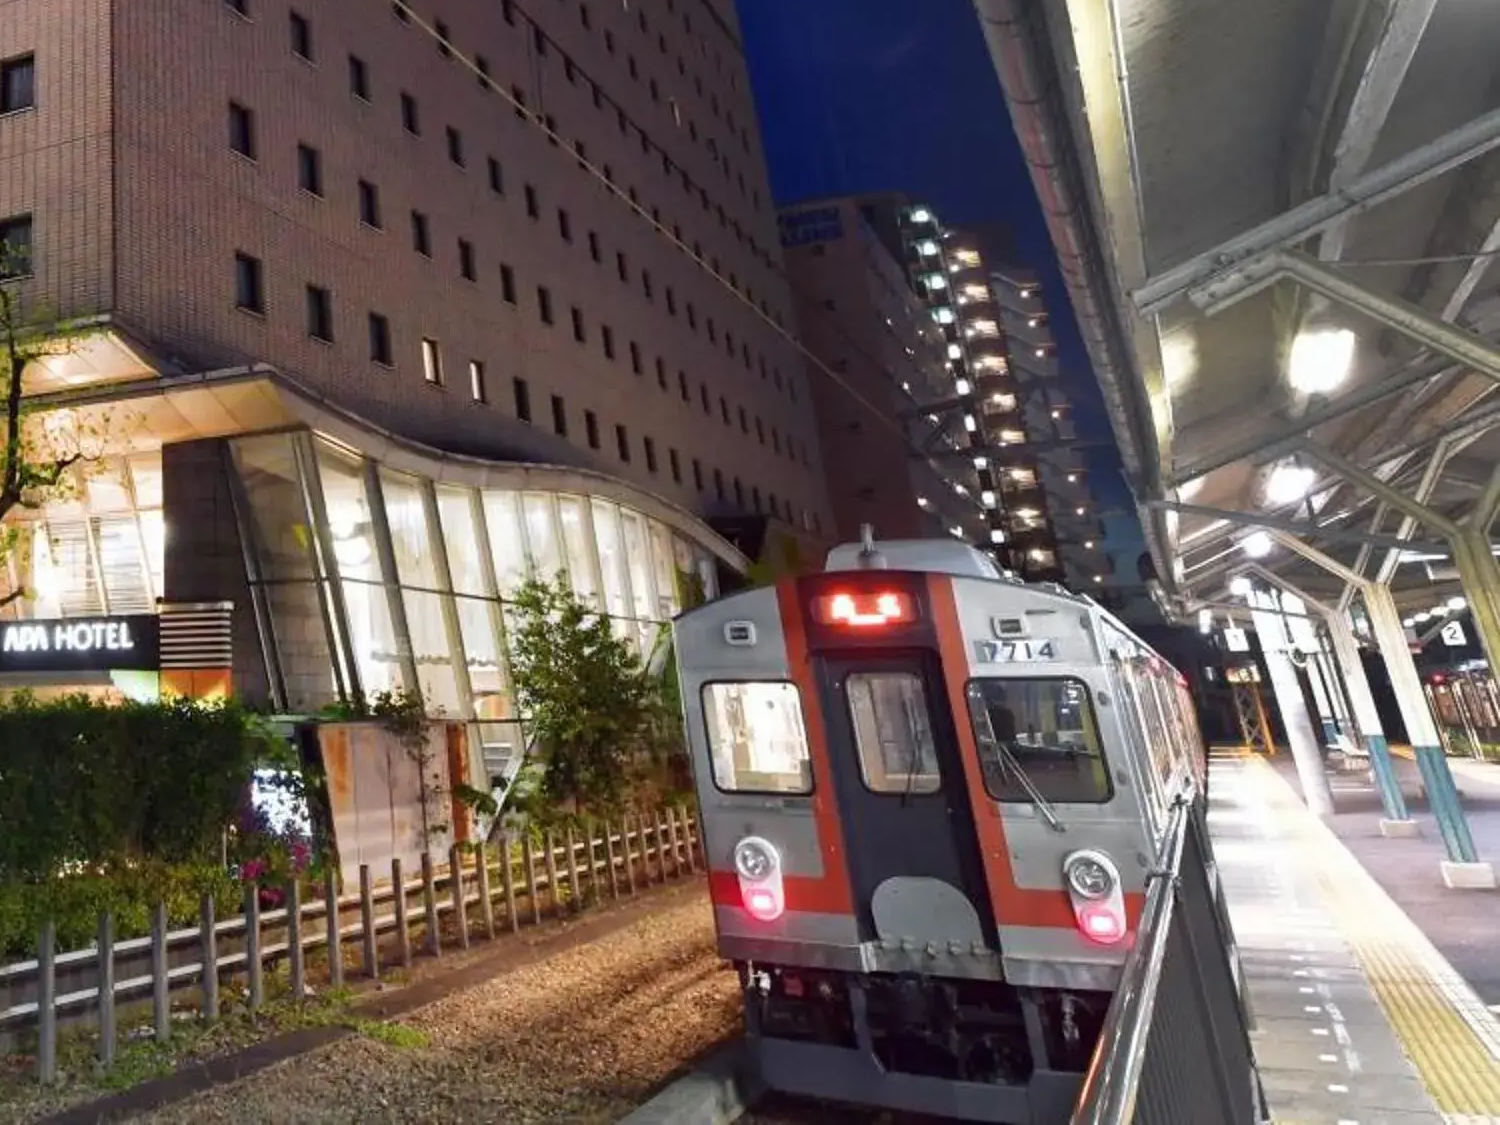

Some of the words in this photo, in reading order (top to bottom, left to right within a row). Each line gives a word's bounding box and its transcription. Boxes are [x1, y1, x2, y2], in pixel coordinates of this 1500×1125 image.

[3, 625, 49, 652] APA
[55, 622, 134, 651] HOTEL
[1446, 626, 1459, 640] 2
[982, 641, 1054, 660] 7714
